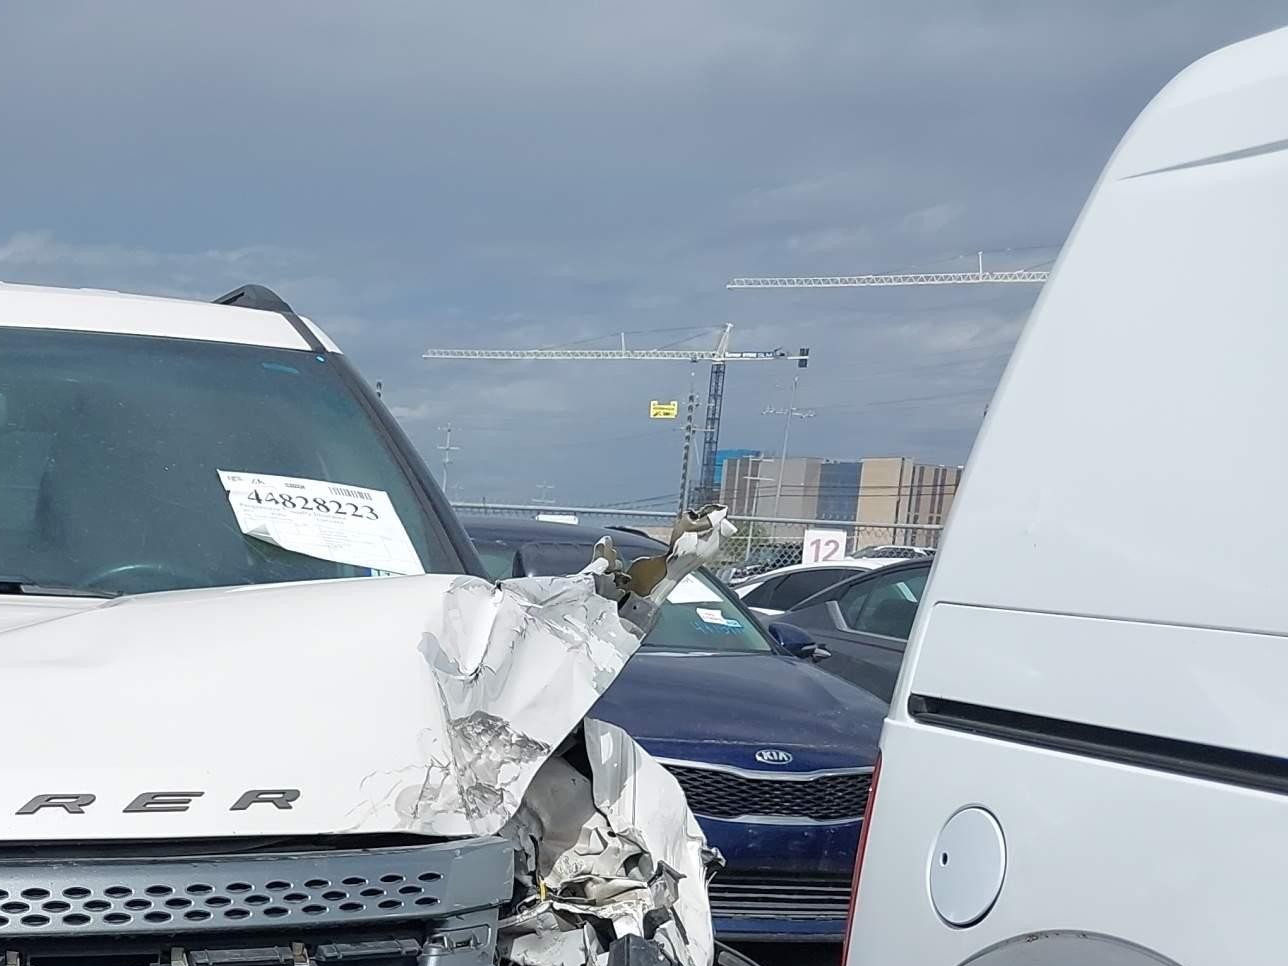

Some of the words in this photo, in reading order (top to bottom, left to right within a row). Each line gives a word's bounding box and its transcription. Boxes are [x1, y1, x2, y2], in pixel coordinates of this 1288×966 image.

[247, 489, 380, 521] 44828223
[810, 538, 840, 563] 12
[760, 751, 789, 761] KIA
